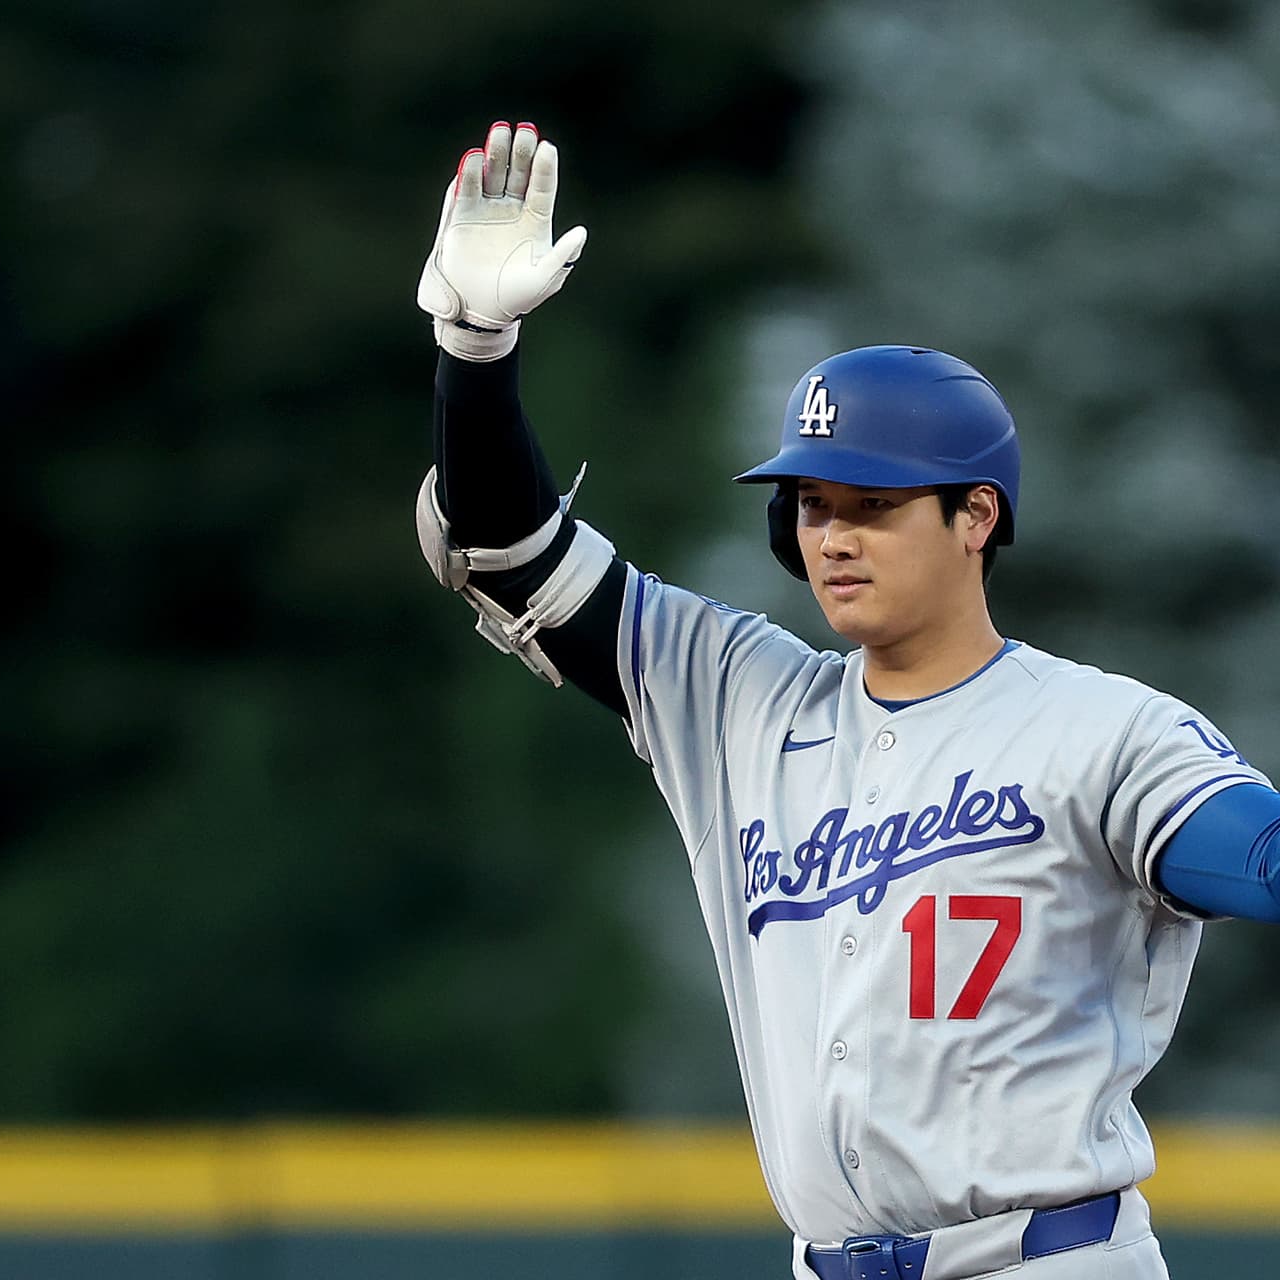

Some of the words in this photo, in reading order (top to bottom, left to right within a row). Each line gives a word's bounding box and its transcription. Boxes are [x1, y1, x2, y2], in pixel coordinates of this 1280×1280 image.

[798, 375, 837, 437] LA
[740, 818, 783, 903] Los
[779, 769, 1044, 915] Angeles
[901, 895, 1022, 1020] 17
